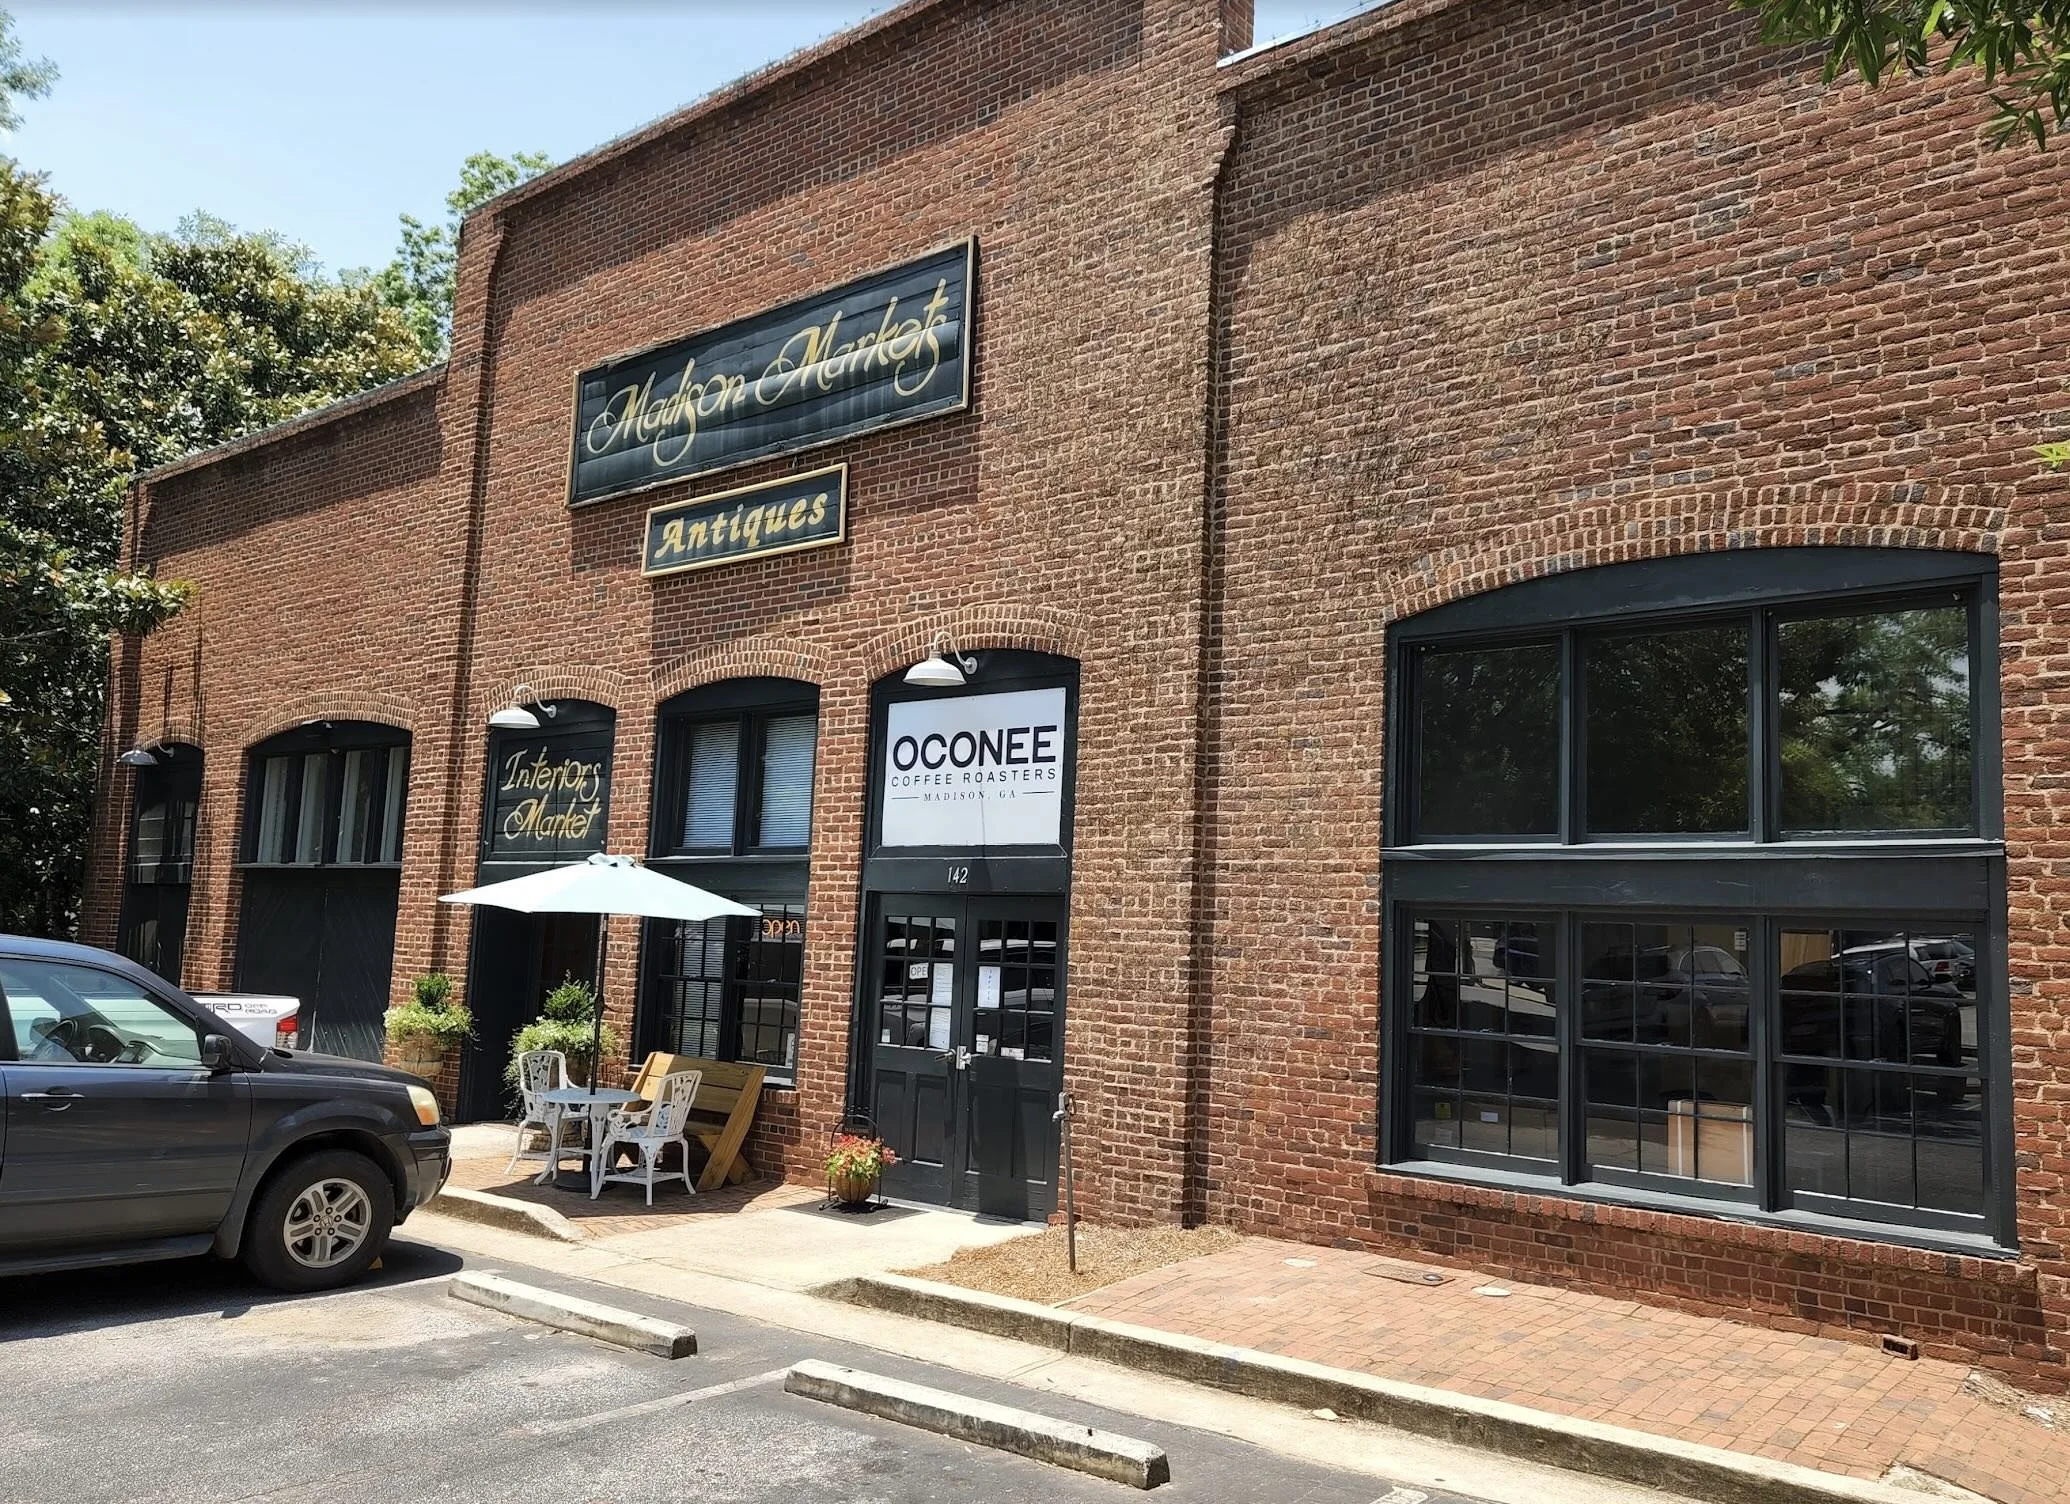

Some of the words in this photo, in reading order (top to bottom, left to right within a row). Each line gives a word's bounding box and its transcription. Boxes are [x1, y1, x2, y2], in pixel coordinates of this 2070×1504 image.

[587, 358, 746, 466] Madison
[755, 278, 949, 405] Markets
[654, 493, 828, 558] Antiques
[893, 725, 1057, 771] OCONEE
[501, 746, 601, 802] Interiors
[891, 773, 952, 787] COFFEE
[963, 768, 1056, 784] ROASTERS
[999, 789, 1016, 799] GA
[504, 793, 601, 840] Market
[947, 866, 968, 884] 142
